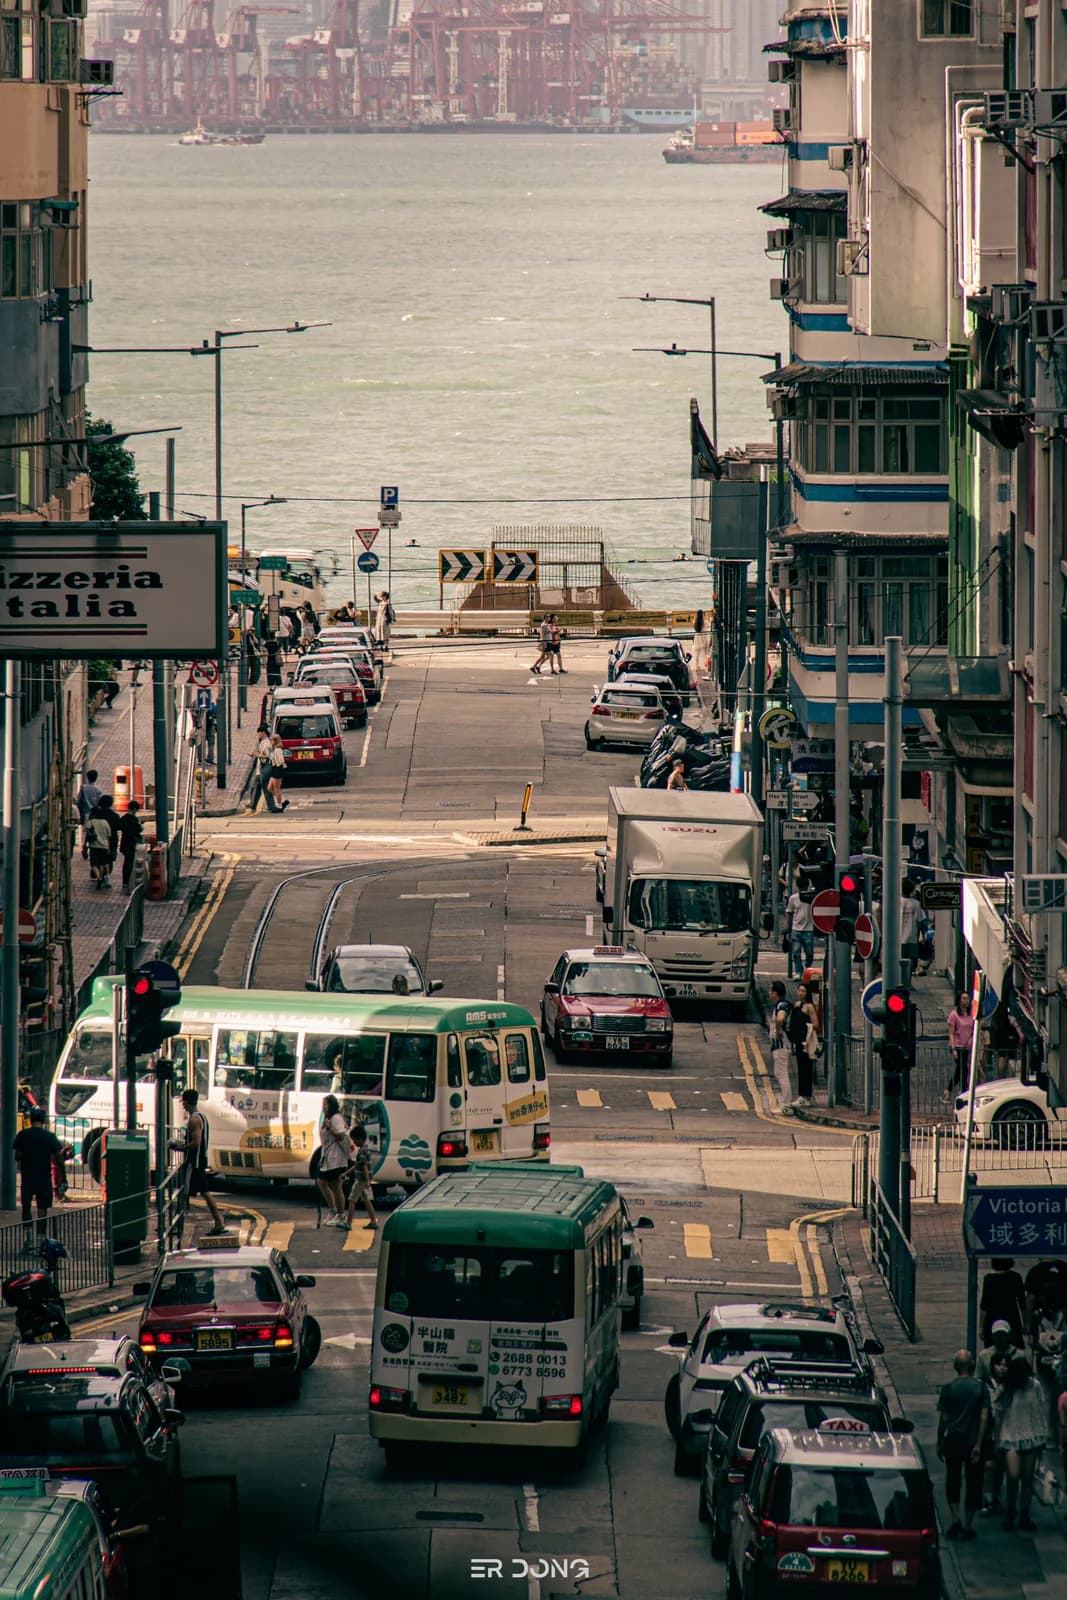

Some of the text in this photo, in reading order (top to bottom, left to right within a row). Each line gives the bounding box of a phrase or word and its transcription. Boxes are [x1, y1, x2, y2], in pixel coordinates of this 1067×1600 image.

[384, 488, 396, 502] P
[988, 1197, 1061, 1214] Victoria
[989, 1221, 1067, 1247] 域多利
[503, 1353, 566, 1365] 2688 0013
[502, 1366, 566, 1378] 6773 8596
[826, 1421, 864, 1431] TAXI
[1, 1469, 46, 1479] TAXI
[841, 1561, 858, 1570] YU
